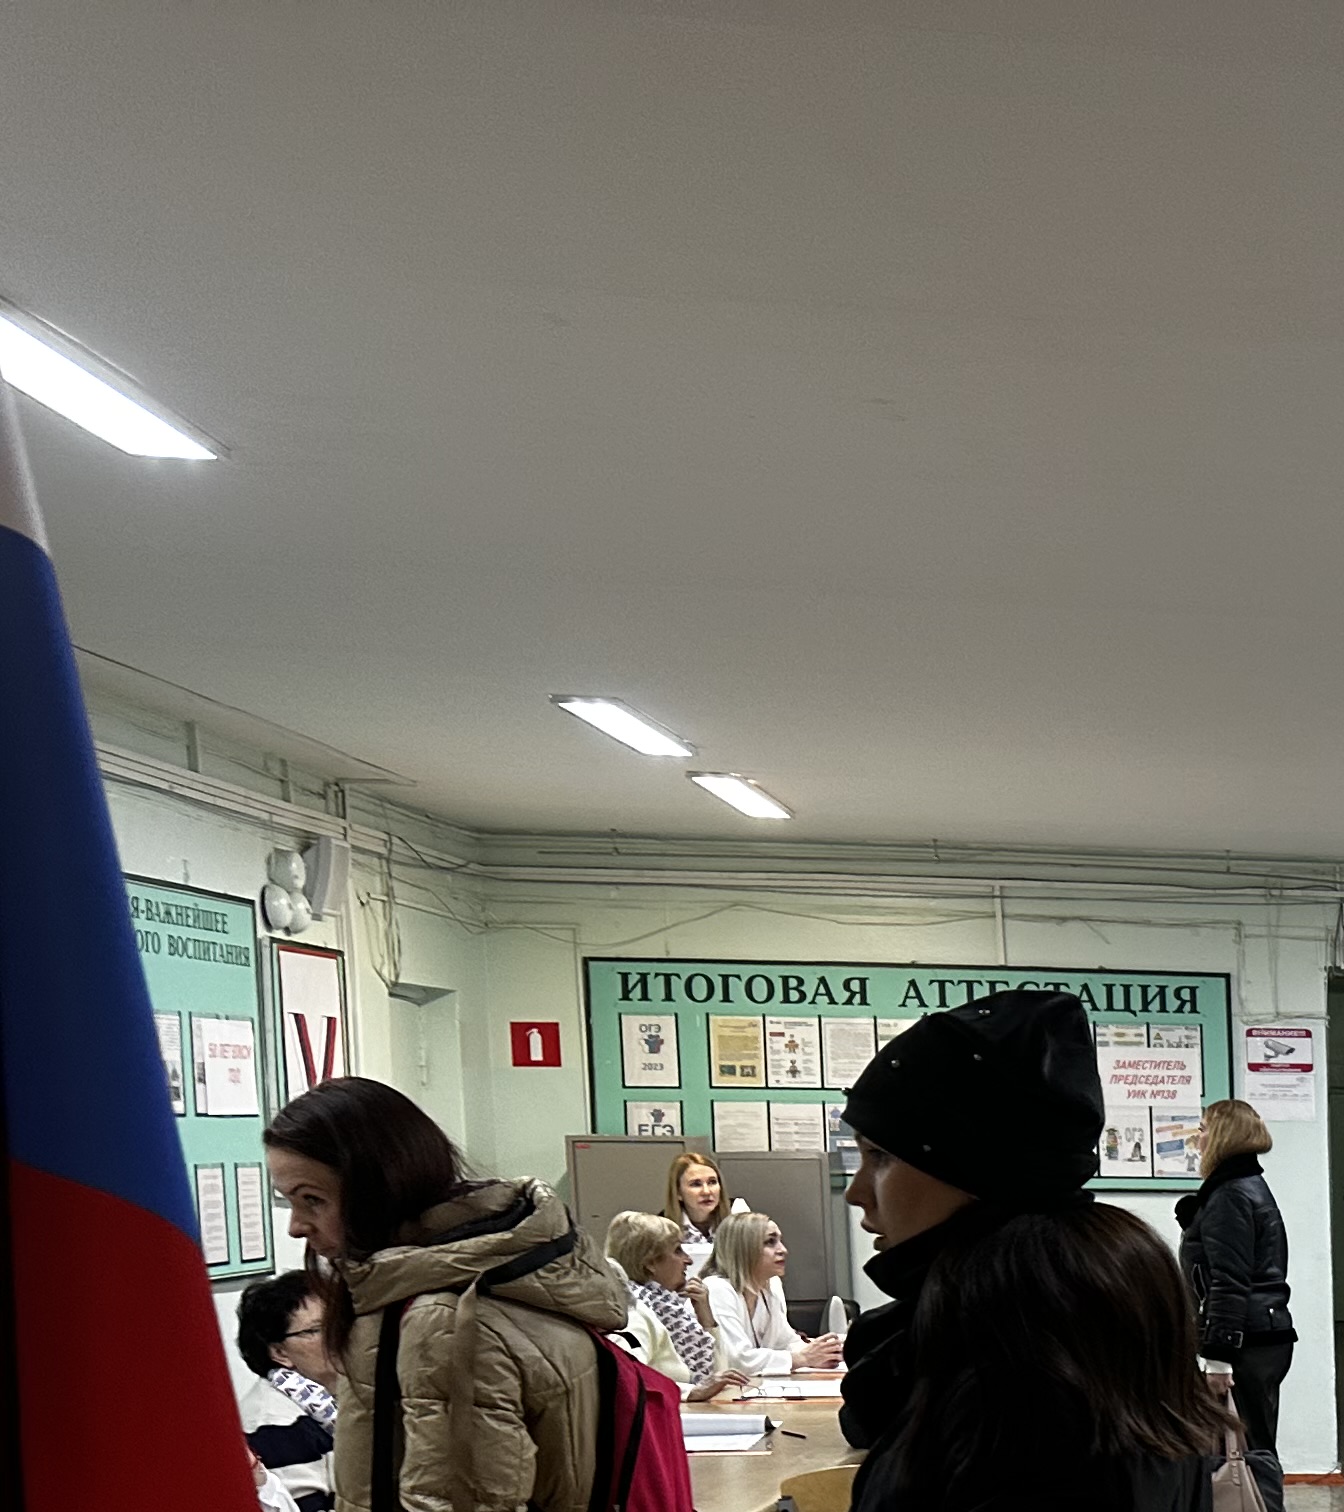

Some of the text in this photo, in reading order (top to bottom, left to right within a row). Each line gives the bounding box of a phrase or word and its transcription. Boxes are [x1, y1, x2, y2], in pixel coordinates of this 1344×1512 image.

[167, 933, 251, 967] ВОСПИТАНИЯ
[617, 971, 1201, 1017] ИТОГОВАЯ АТТАЦИЯ
[638, 1023, 662, 1034] ОГЭ
[1113, 1059, 1187, 1071] ЗАМЕСТИТЕЛЬ
[1109, 1074, 1192, 1086] ПРЕДСЕДАТЕЛЯ
[1126, 1089, 1147, 1100] УИК
